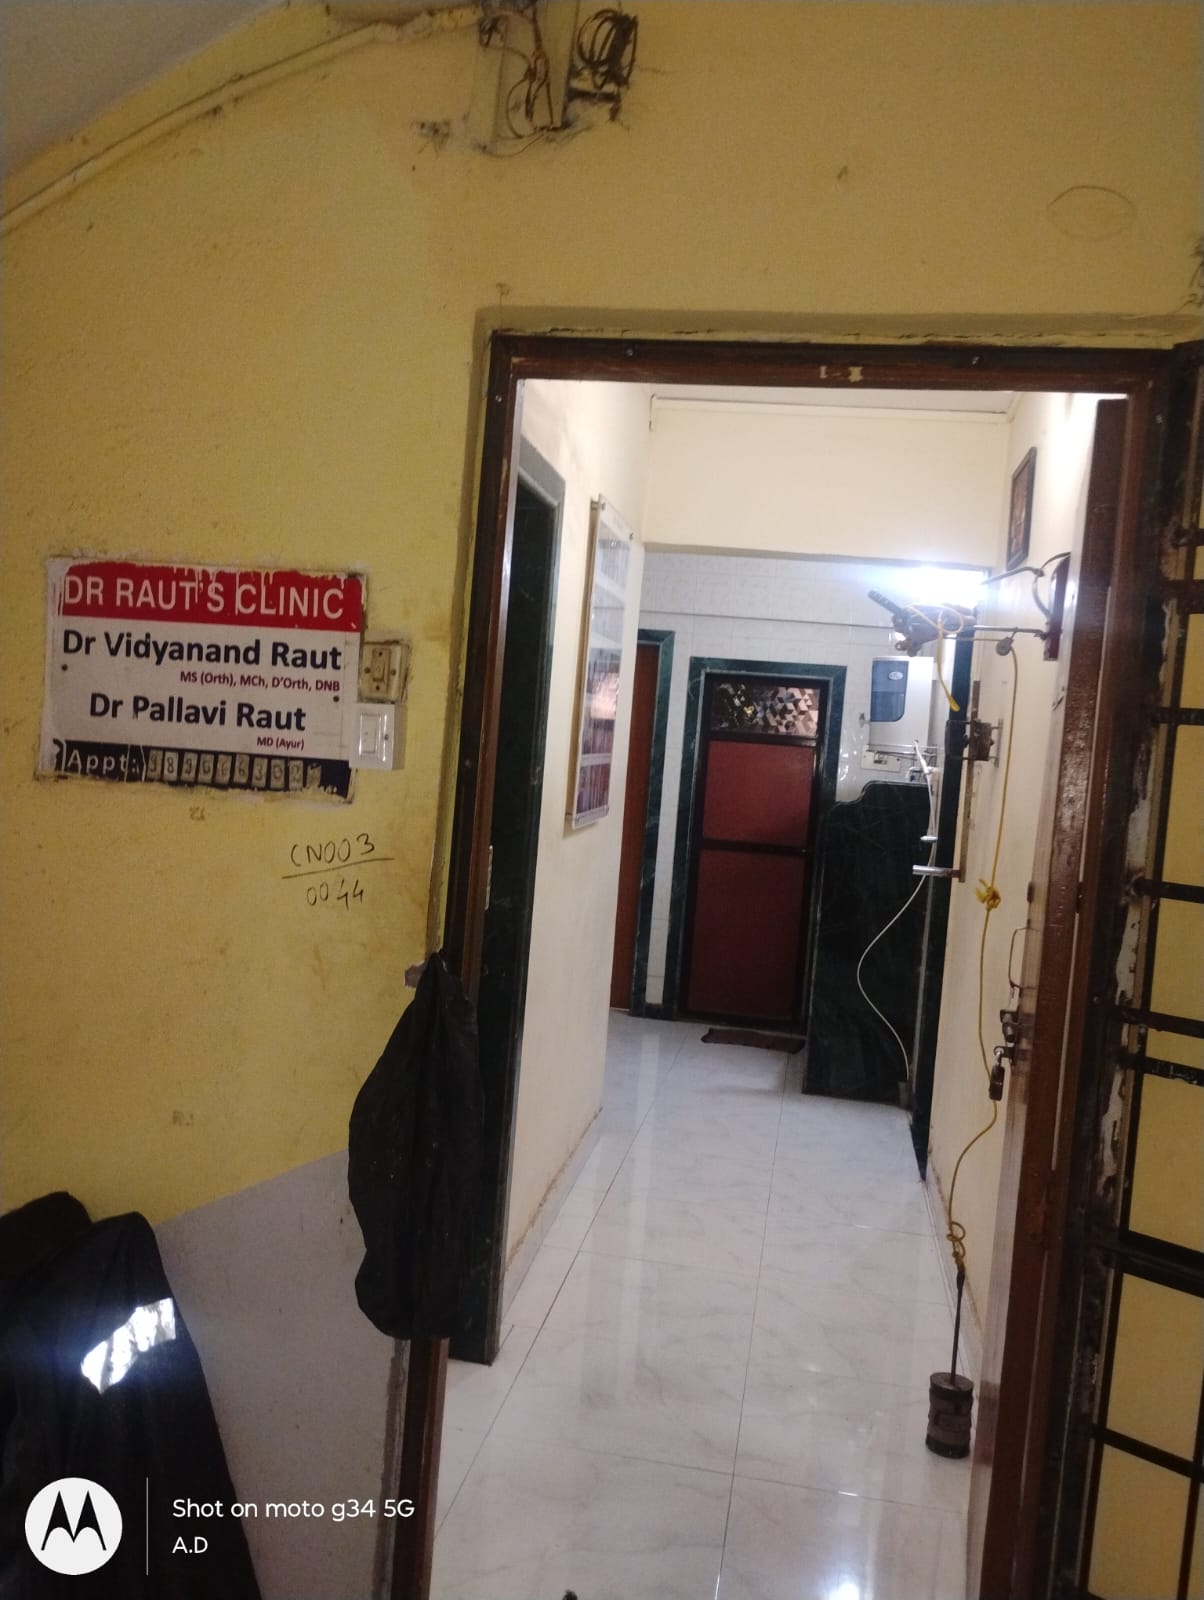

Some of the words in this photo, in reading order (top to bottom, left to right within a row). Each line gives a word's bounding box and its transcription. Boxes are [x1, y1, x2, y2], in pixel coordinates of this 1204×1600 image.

[64, 575, 104, 606] DR
[115, 577, 225, 613] RAUT'S
[236, 584, 344, 619] CLINIC
[63, 630, 96, 654] Dr
[104, 632, 261, 669] Vidyanand
[271, 642, 341, 670] Raut
[180, 671, 198, 683] MS
[200, 672, 237, 688] (Orth),
[240, 675, 268, 689] MCh,
[271, 677, 312, 692] D'Orth,
[315, 680, 340, 692] DNB
[90, 693, 123, 718] Dr
[133, 696, 226, 726] Pallavi
[236, 702, 306, 731] Raut
[256, 737, 274, 747] MD
[275, 737, 305, 751] (Ayur)
